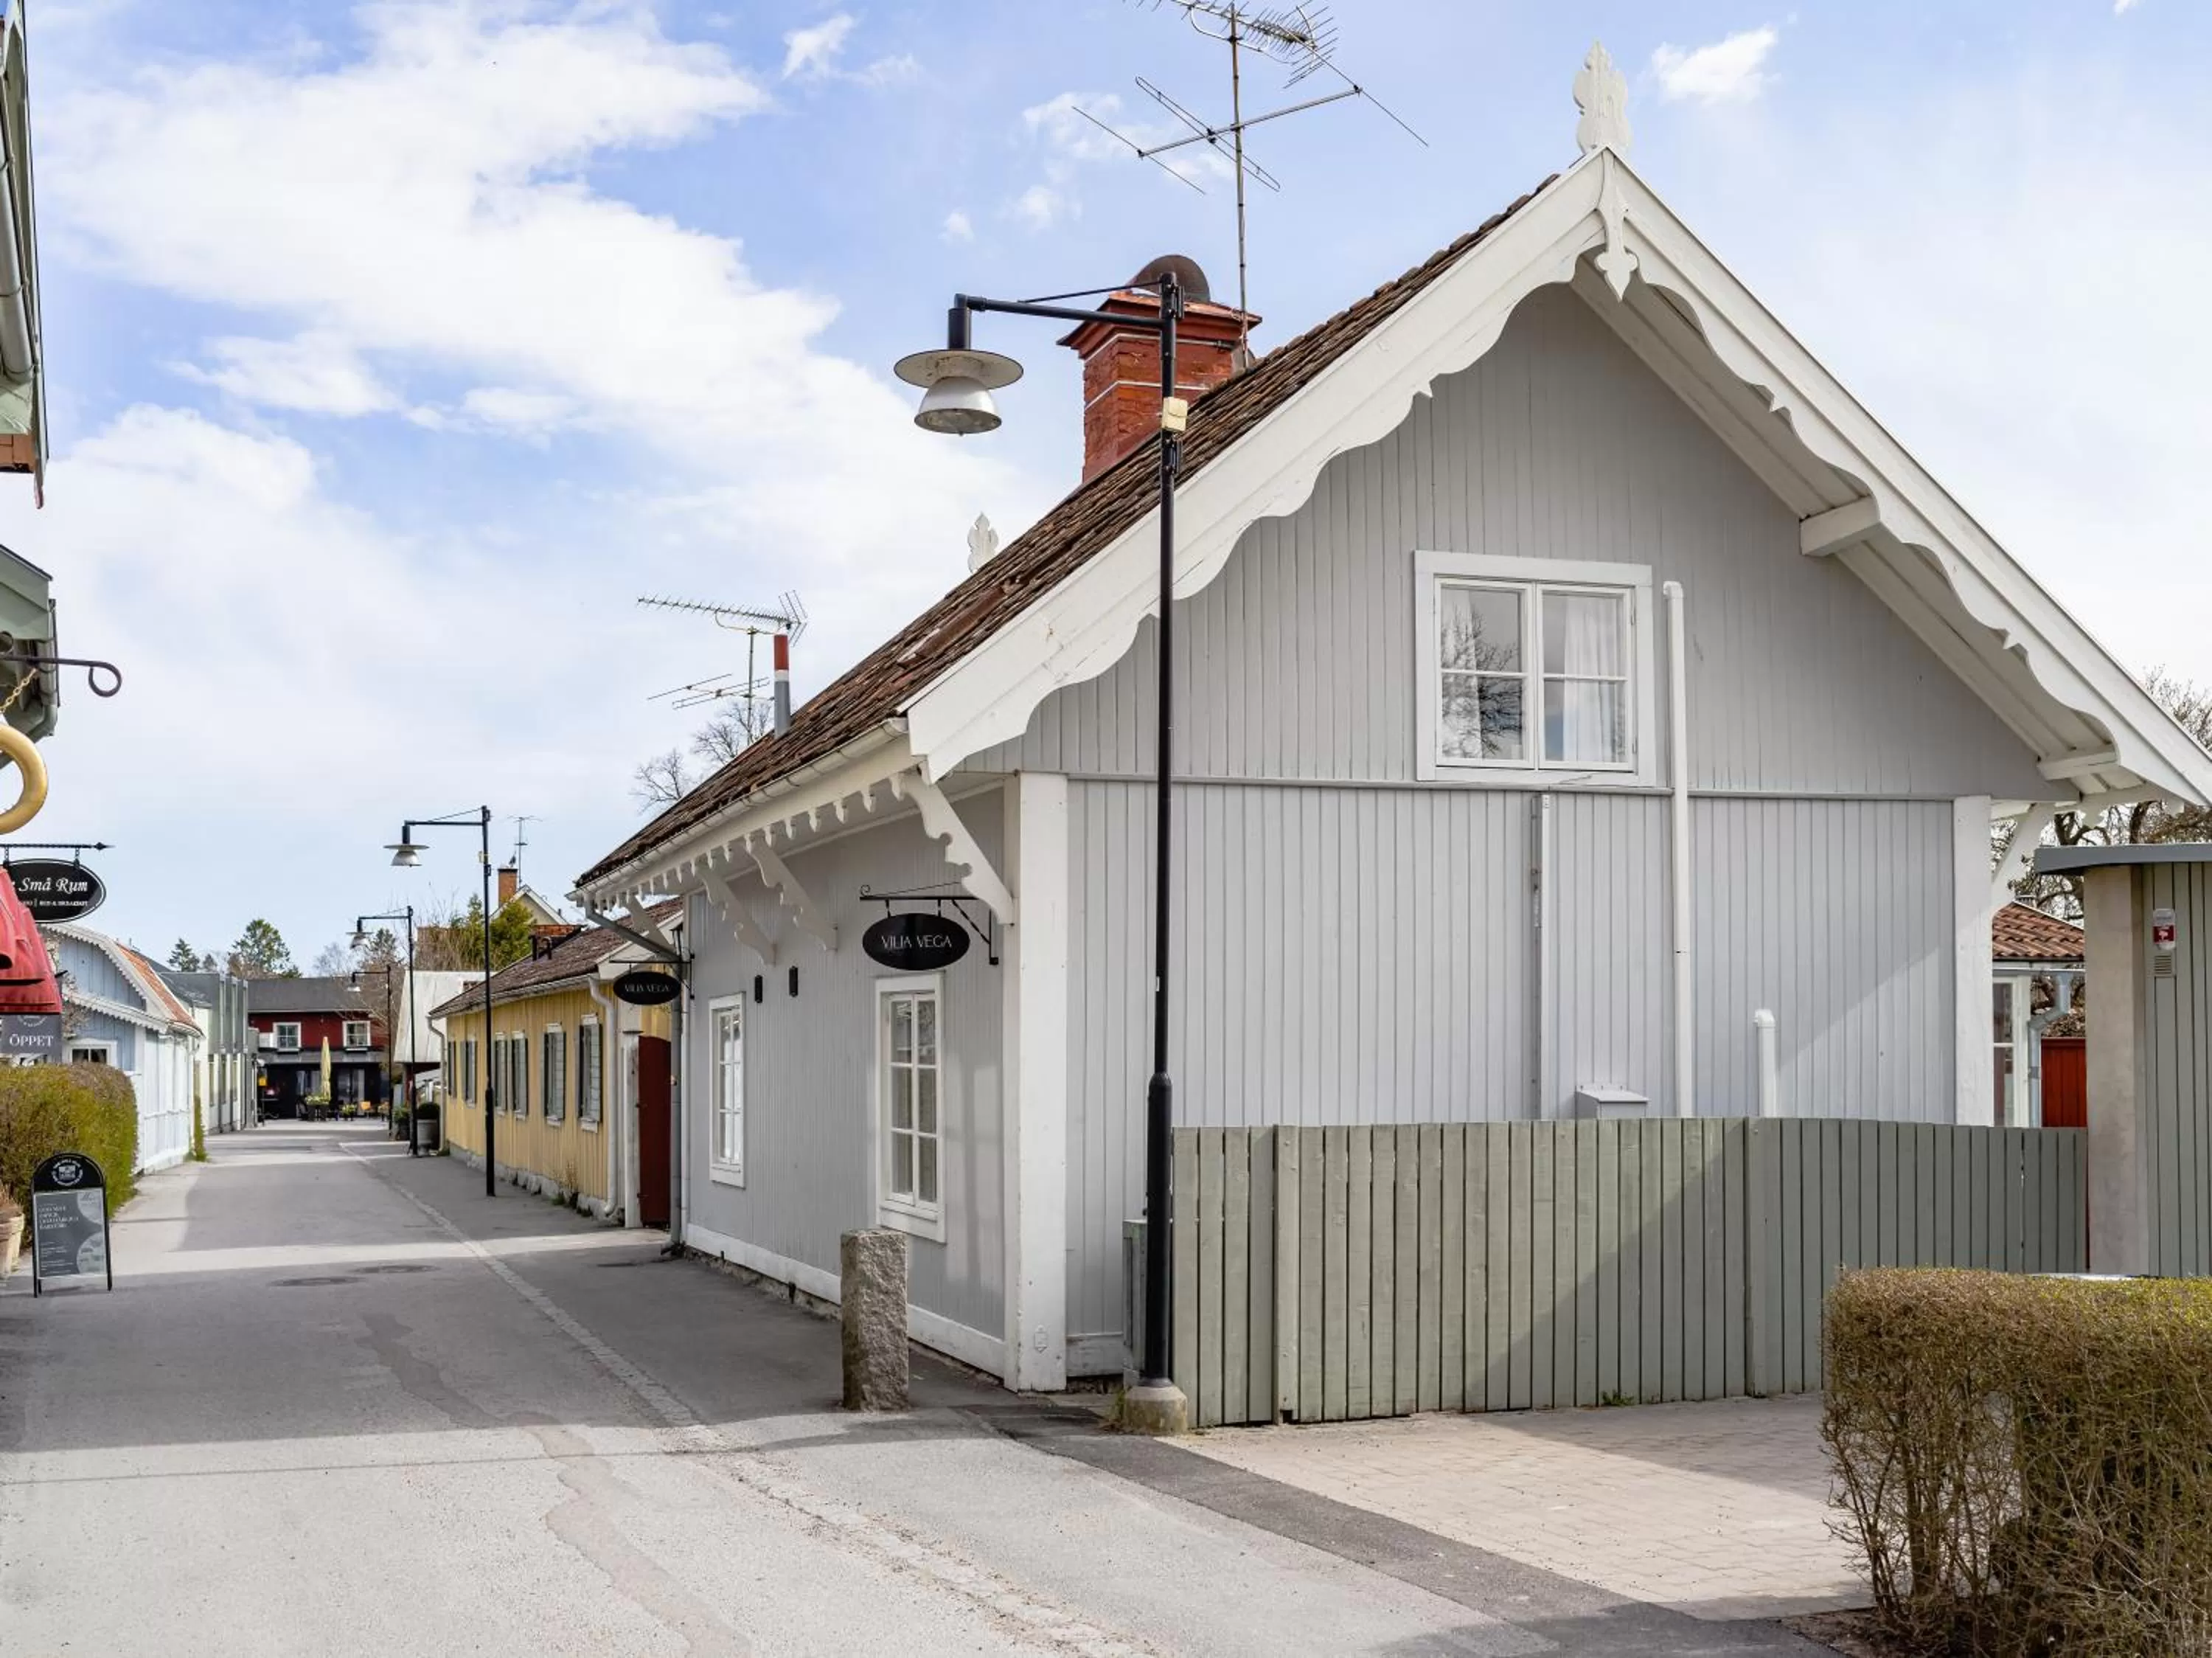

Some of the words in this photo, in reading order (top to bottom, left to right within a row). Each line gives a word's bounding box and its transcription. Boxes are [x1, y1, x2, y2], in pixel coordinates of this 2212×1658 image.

[18, 877, 52, 892] Små
[55, 877, 88, 894] Rum
[917, 934, 953, 948] VEGA
[9, 1033, 54, 1047] ÖPPET
